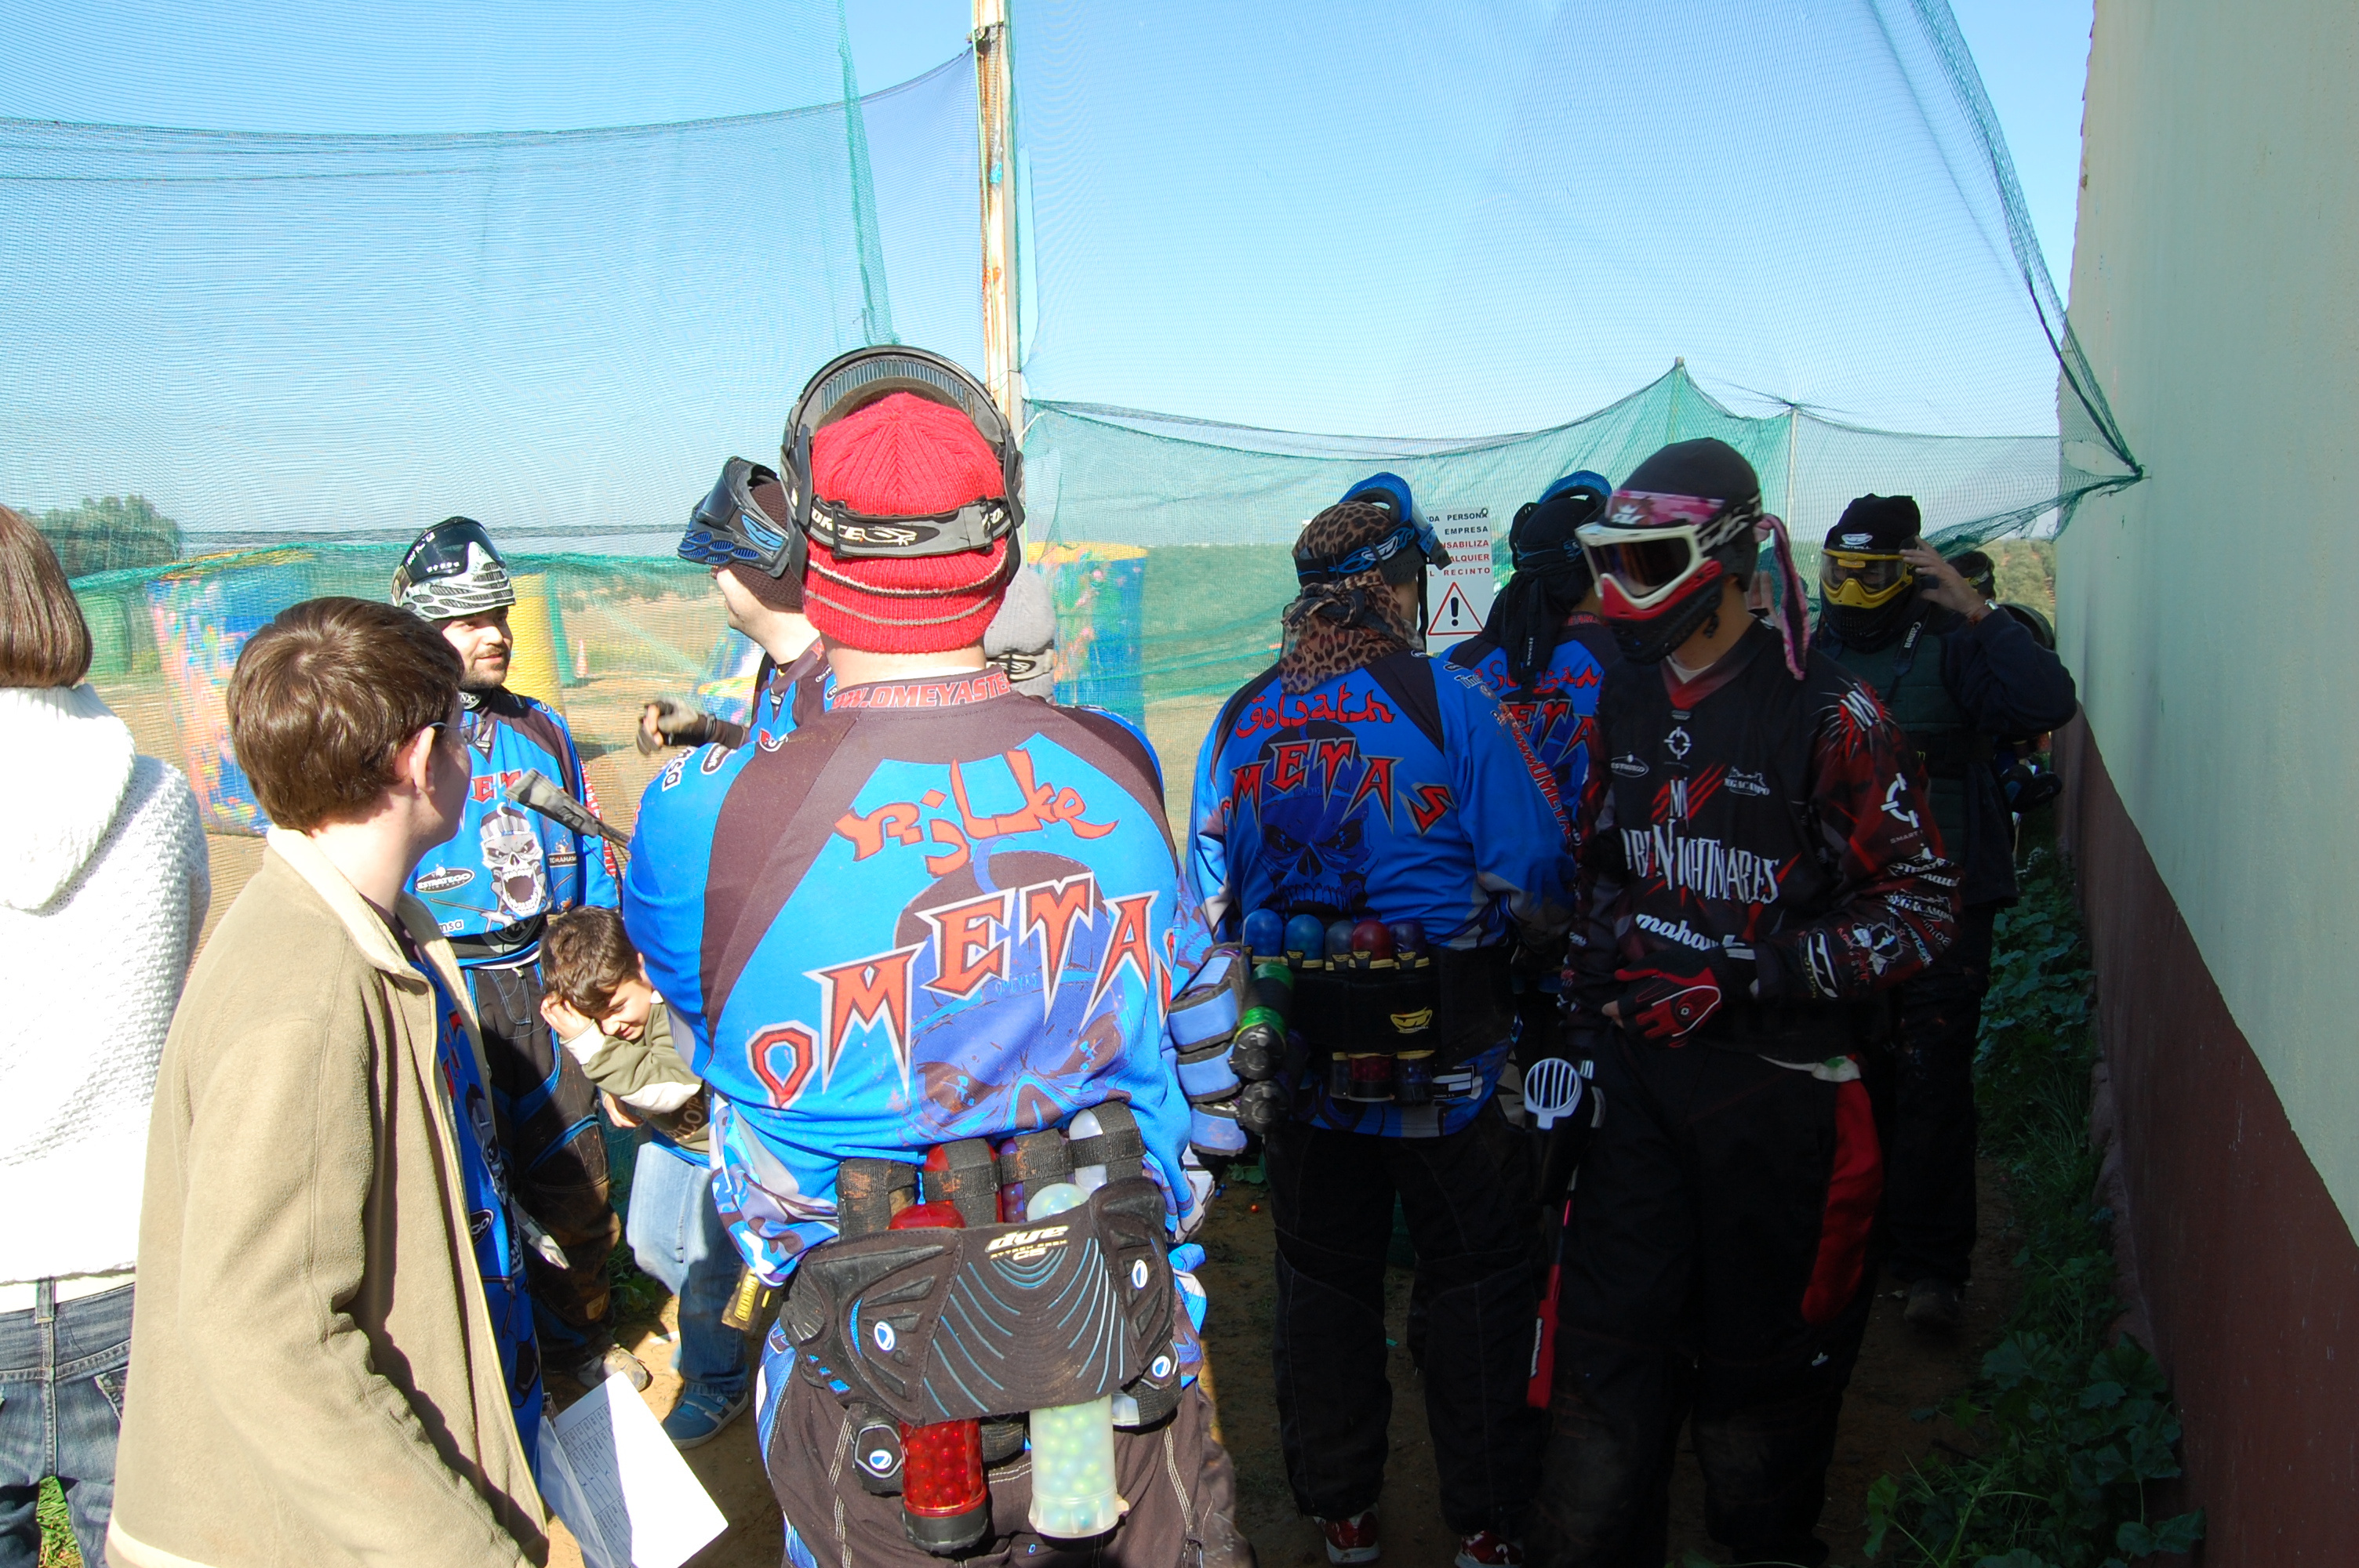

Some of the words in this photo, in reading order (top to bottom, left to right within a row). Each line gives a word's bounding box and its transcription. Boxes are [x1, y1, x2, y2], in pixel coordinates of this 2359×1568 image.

[1447, 512, 1488, 521] PERSONA
[1445, 526, 1488, 535] EMPRESA
[1443, 567, 1490, 576] RECINTO
[1903, 621, 1921, 648] Canon
[985, 1225, 1070, 1253] dye
